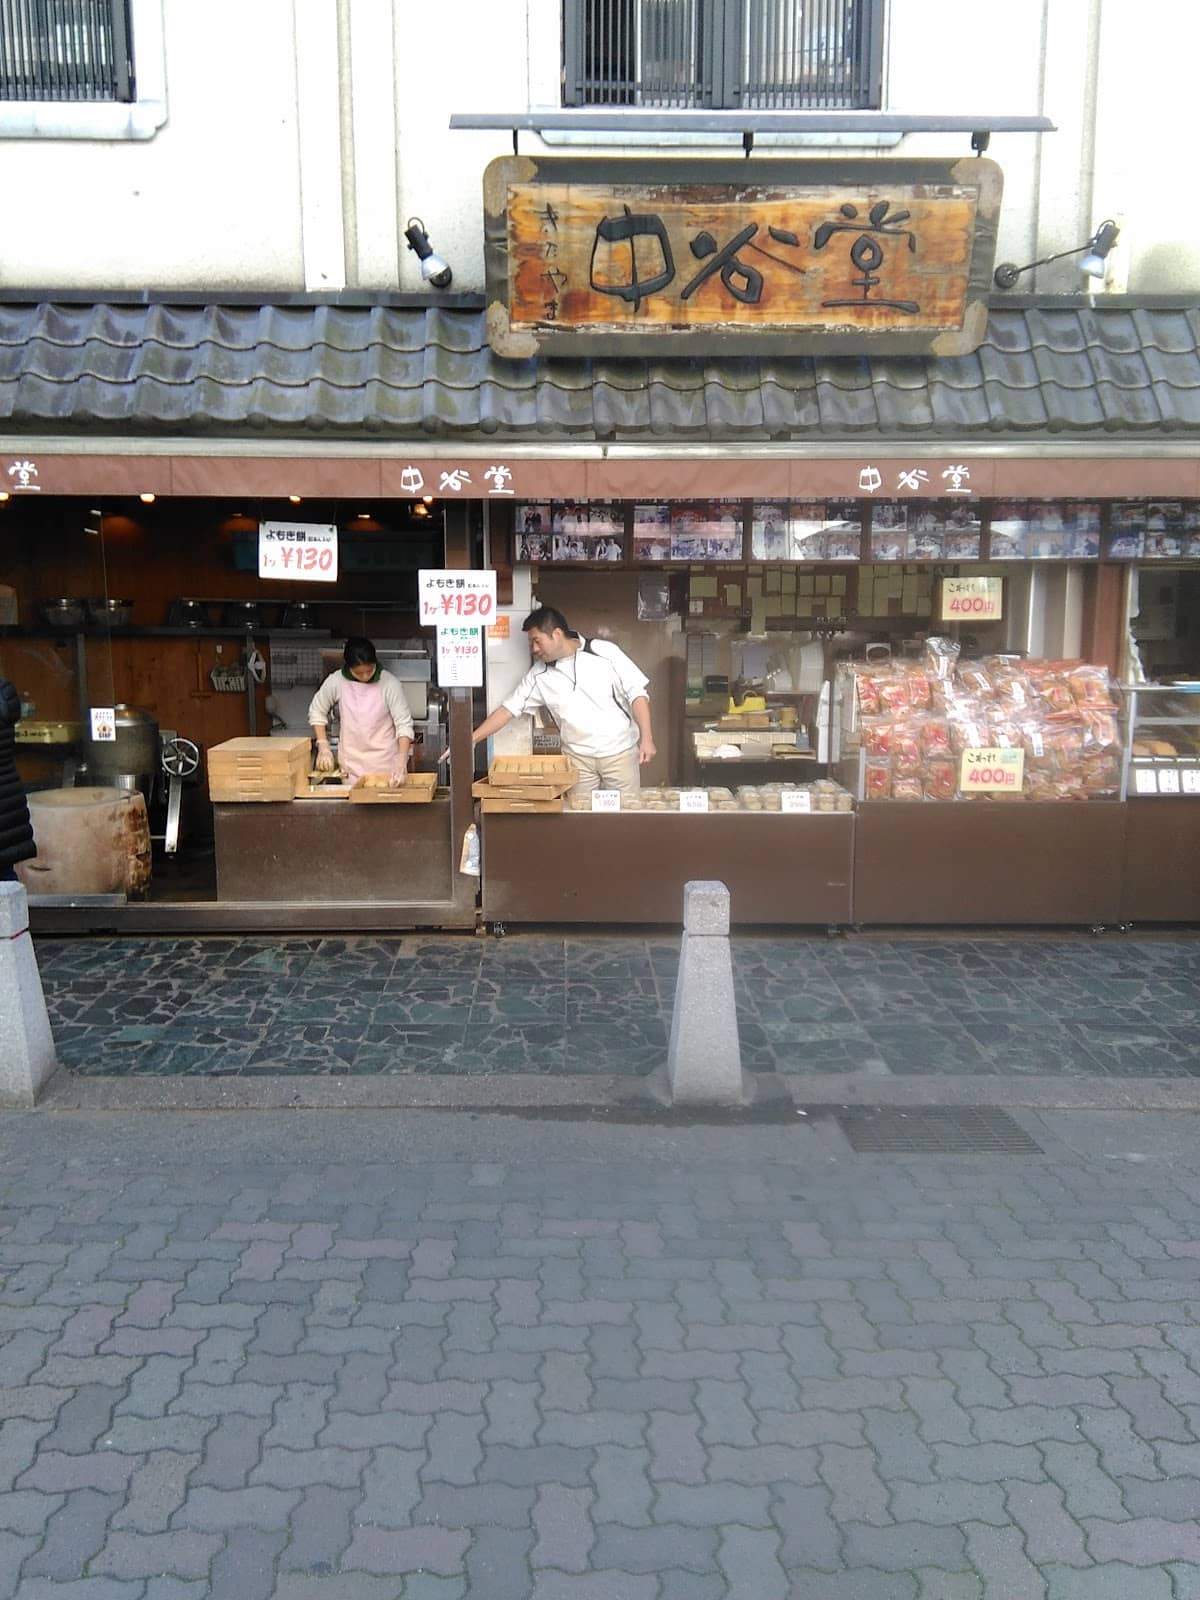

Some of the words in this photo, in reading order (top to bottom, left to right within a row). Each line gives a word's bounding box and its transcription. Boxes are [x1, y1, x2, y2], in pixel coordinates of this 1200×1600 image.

[589, 203, 920, 314] 中谷堂
[400, 465, 515, 494] 中谷堂
[858, 465, 972, 494] 中谷堂
[280, 547, 333, 571] ¥130
[440, 593, 492, 616] ¥130
